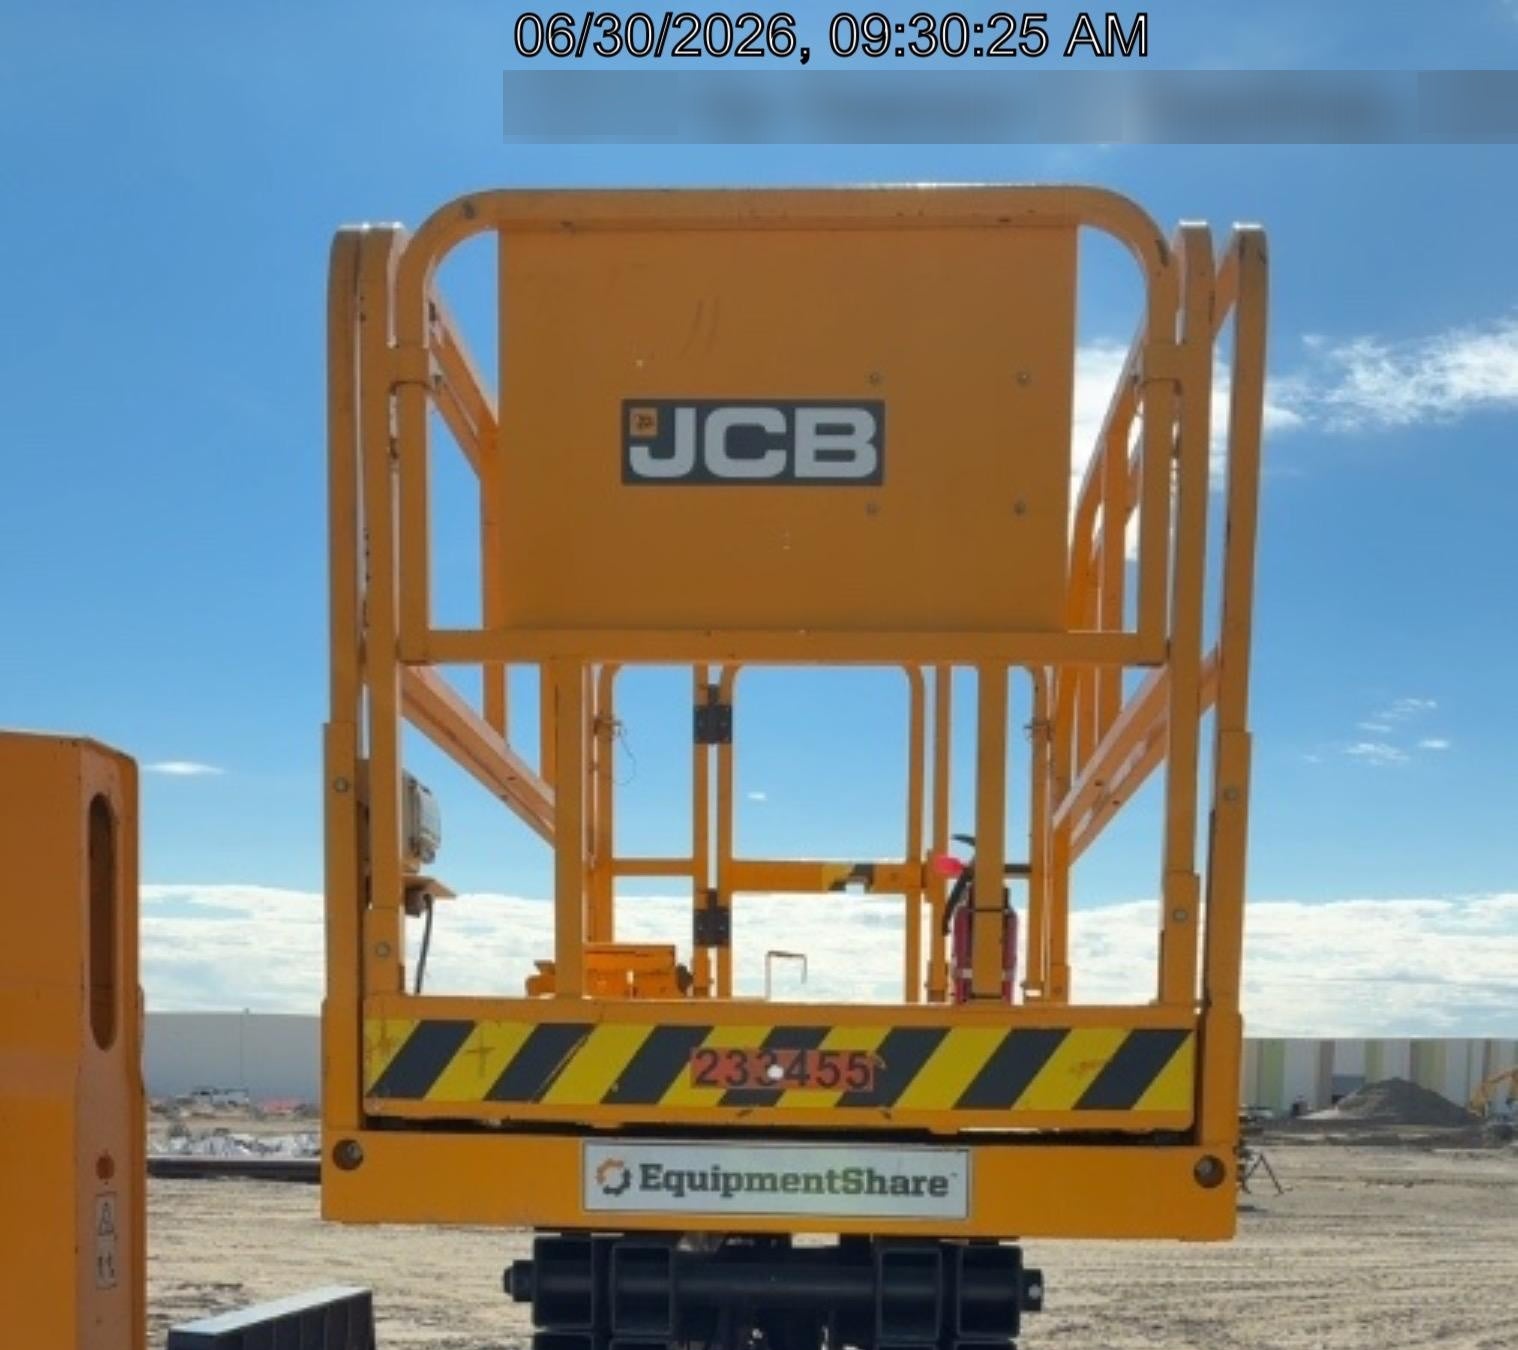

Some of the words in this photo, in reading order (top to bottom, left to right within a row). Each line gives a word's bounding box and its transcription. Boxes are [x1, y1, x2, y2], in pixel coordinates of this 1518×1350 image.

[629, 407, 877, 478] JCB
[695, 1049, 872, 1088] 233455
[638, 1163, 950, 1198] EquipmentShare
